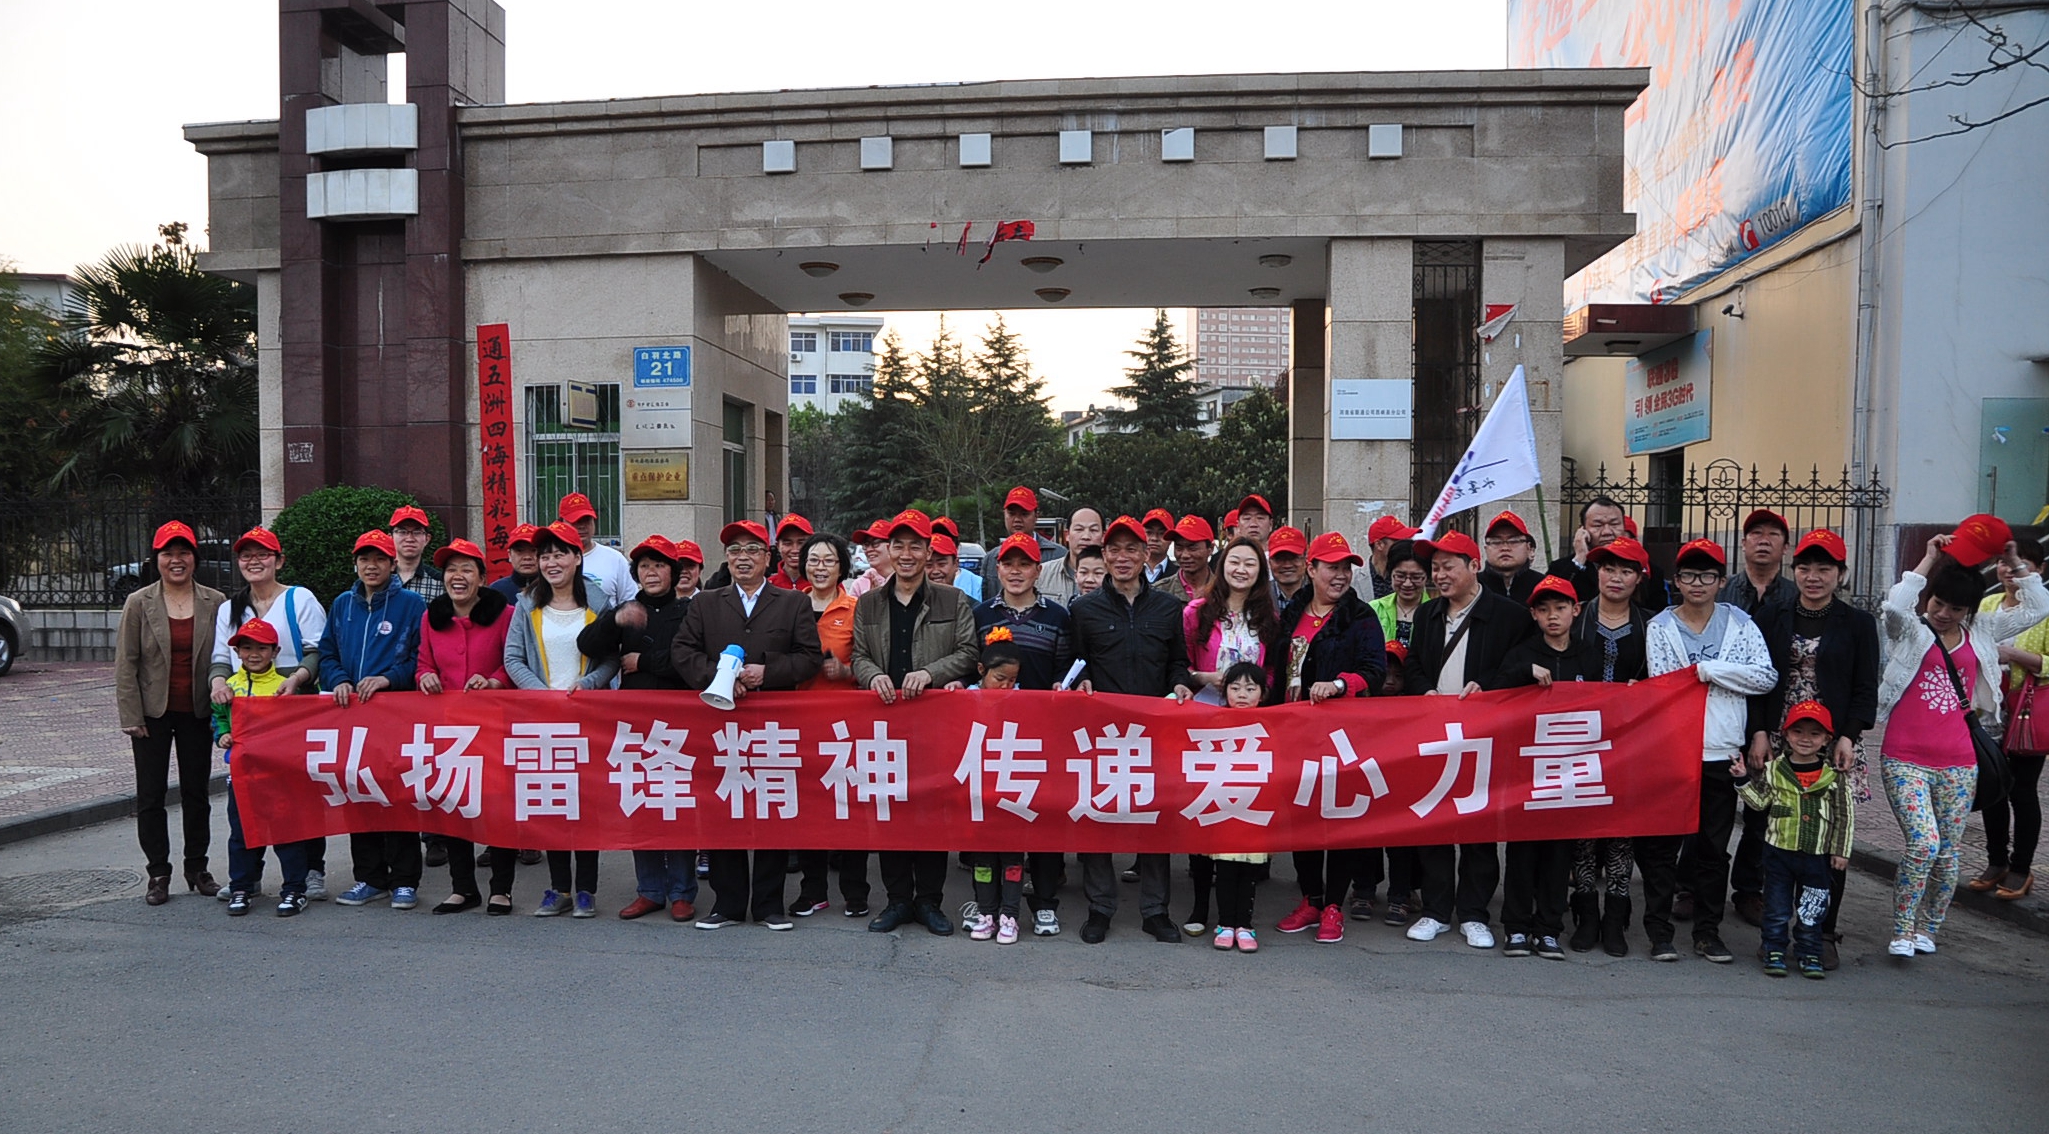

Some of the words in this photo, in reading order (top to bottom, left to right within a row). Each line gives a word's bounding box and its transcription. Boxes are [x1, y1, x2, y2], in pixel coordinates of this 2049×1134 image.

[1758, 202, 1791, 235] 10010
[650, 361, 672, 376] 21
[1646, 357, 1679, 389] 联通3G
[482, 335, 511, 578] 通五洲四海精彩每一
[631, 471, 682, 482] 重点保护企业
[305, 719, 909, 822] 弘扬雷锋精神
[953, 710, 1614, 827] 传递爱心力量
